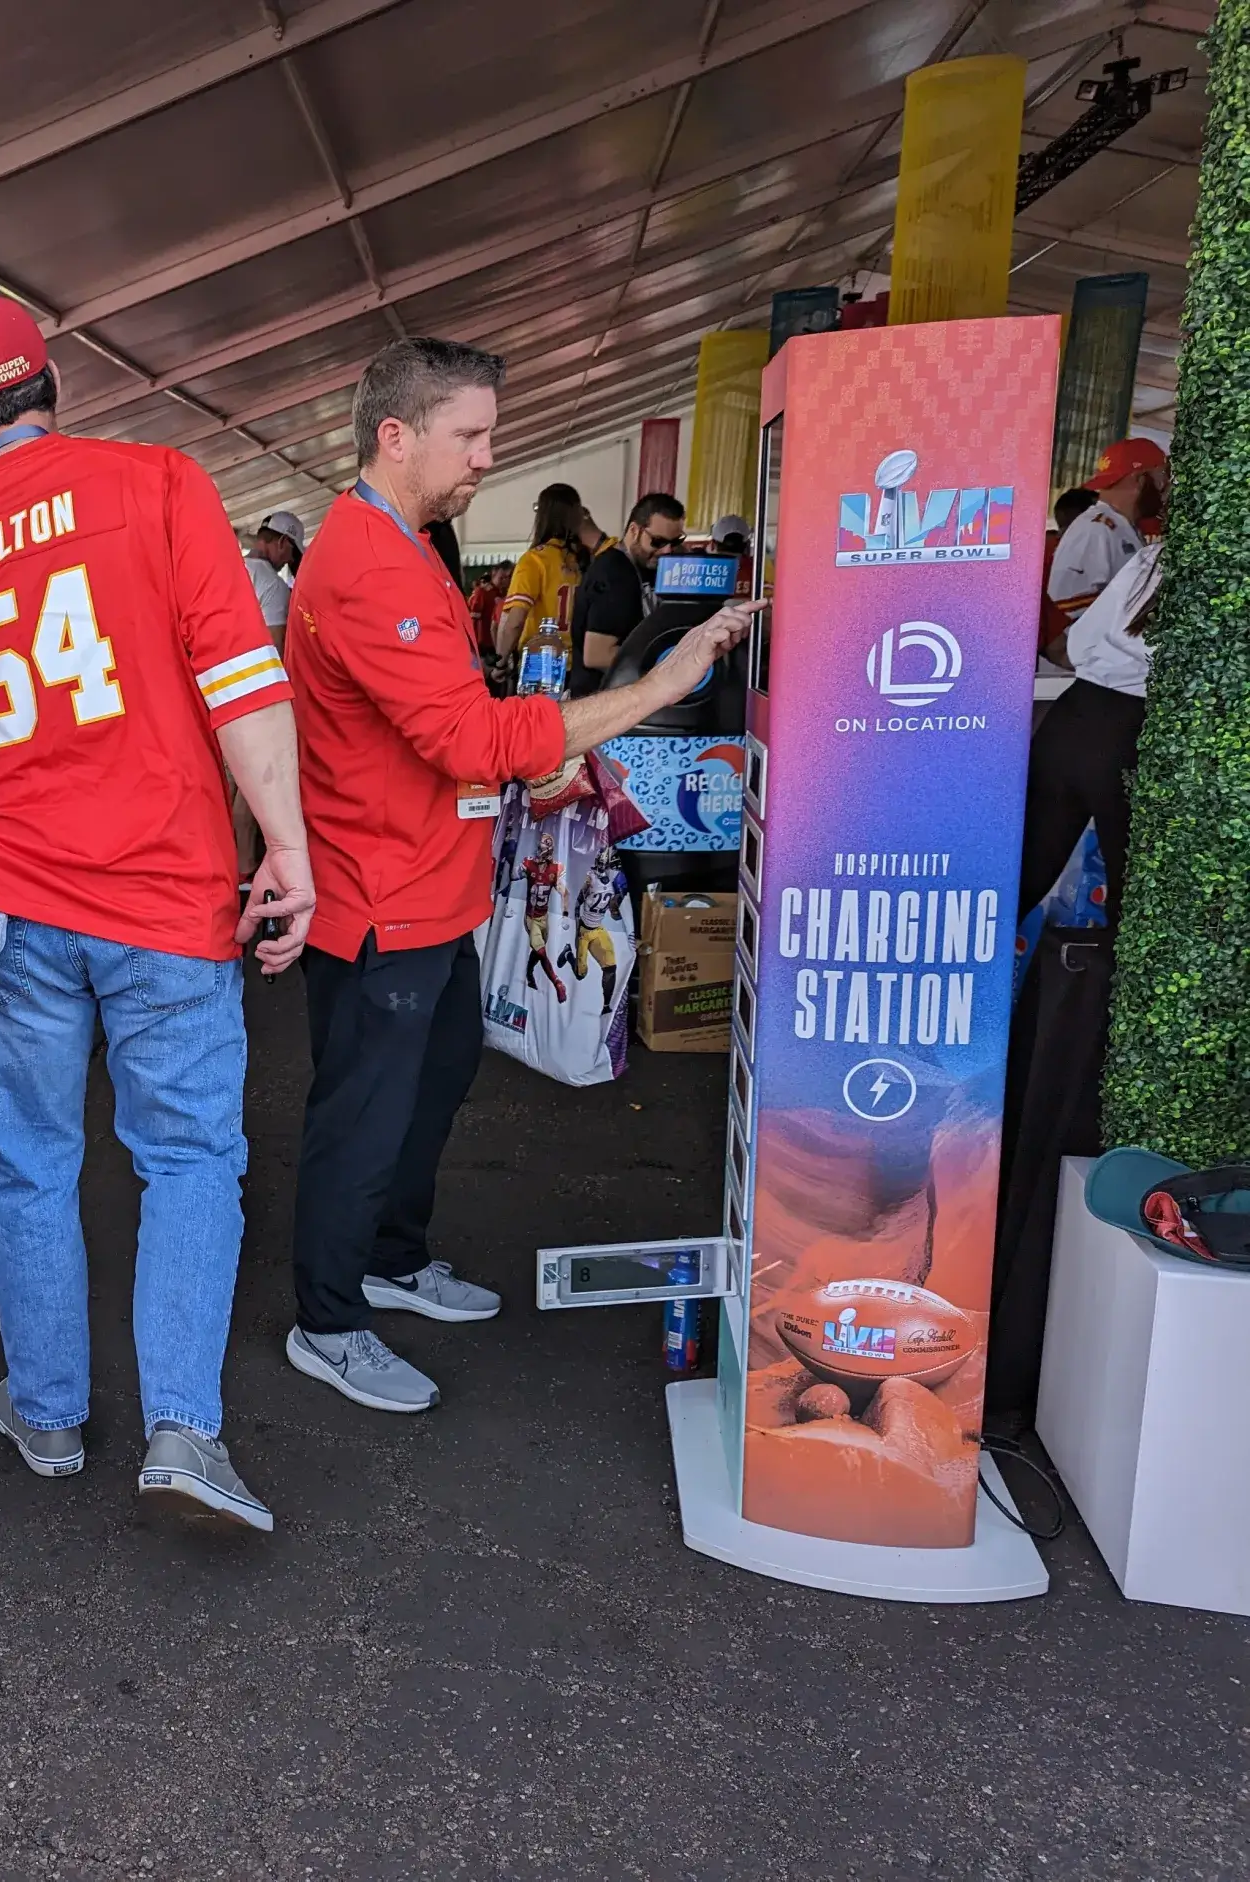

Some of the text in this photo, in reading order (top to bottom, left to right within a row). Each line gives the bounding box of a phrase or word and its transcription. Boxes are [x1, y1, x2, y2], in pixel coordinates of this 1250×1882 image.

[837, 486, 1014, 551] LVII
[850, 547, 996, 564] SUPER BOWL
[680, 576, 728, 588] CANS ONLY
[835, 716, 986, 733] ON LOCATION
[701, 795, 742, 812] HERE
[835, 853, 950, 876] HOSPITALITY
[779, 887, 998, 963] CHARGING
[688, 987, 727, 1001] CLASSIC
[795, 969, 973, 1045] STATION
[580, 1267, 591, 1283] 8
[784, 1321, 812, 1339] Wilson
[829, 1346, 857, 1354] SUPER
[902, 1345, 961, 1353] COMMISSIONER
